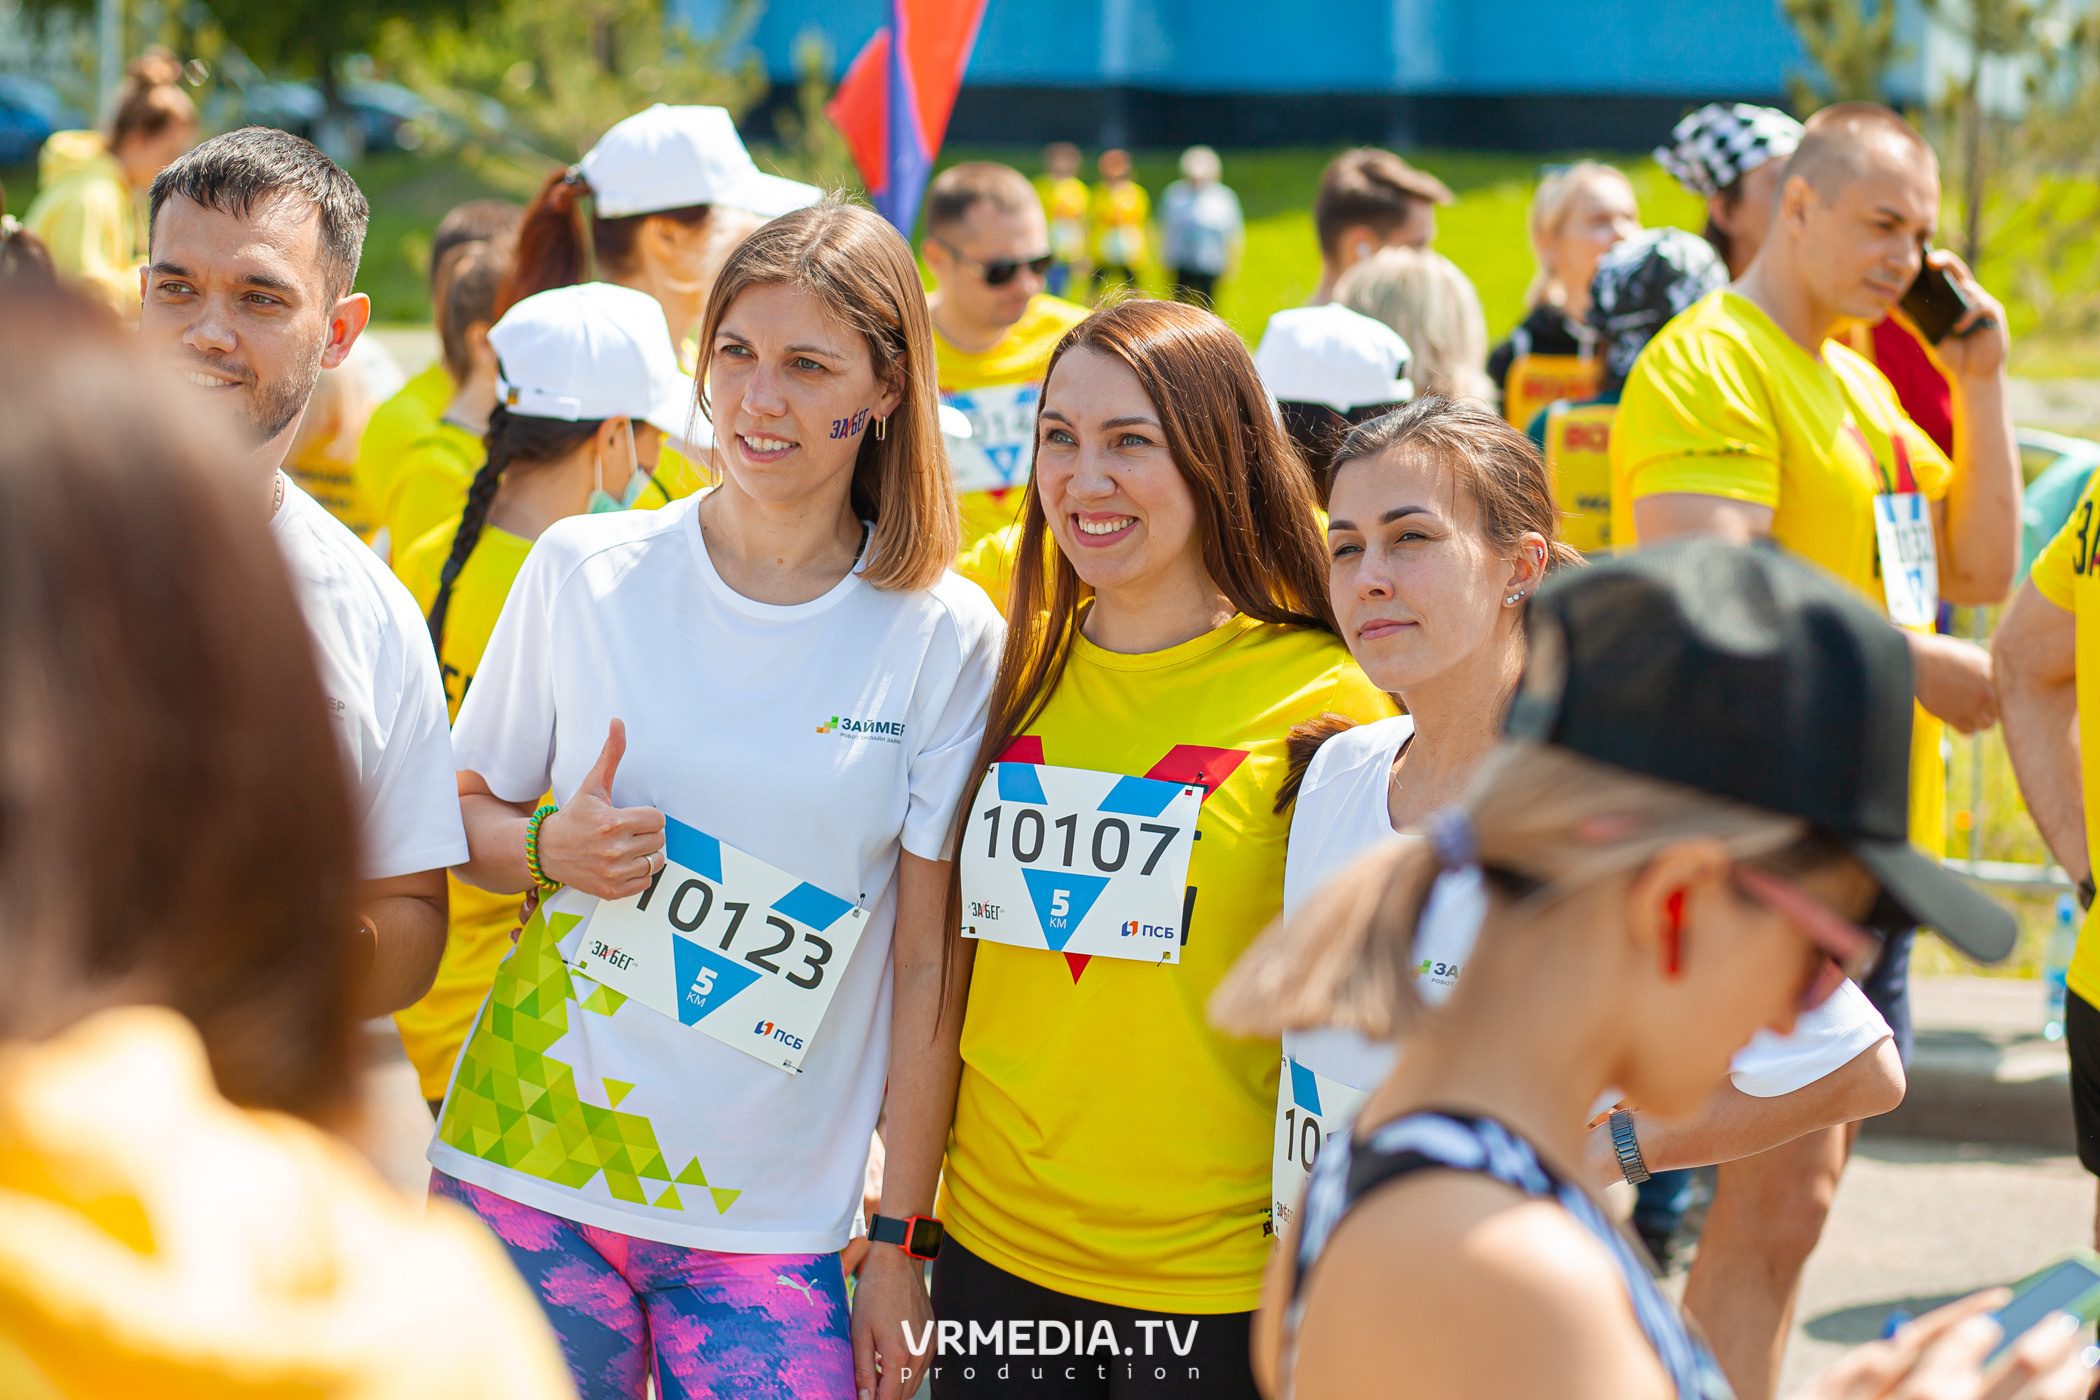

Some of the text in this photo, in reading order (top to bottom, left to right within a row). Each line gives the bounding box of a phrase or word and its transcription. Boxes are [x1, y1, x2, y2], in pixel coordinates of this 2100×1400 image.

[829, 407, 870, 440] ЗАБЕГ
[983, 805, 1181, 876] 10107
[1050, 889, 1071, 918] 5
[635, 863, 834, 991] 10123
[1049, 917, 1068, 930] КМ
[1142, 924, 1175, 940] ПСБ
[690, 966, 719, 996] 5
[685, 990, 707, 1009] КМ
[772, 1028, 804, 1051] ПСБ
